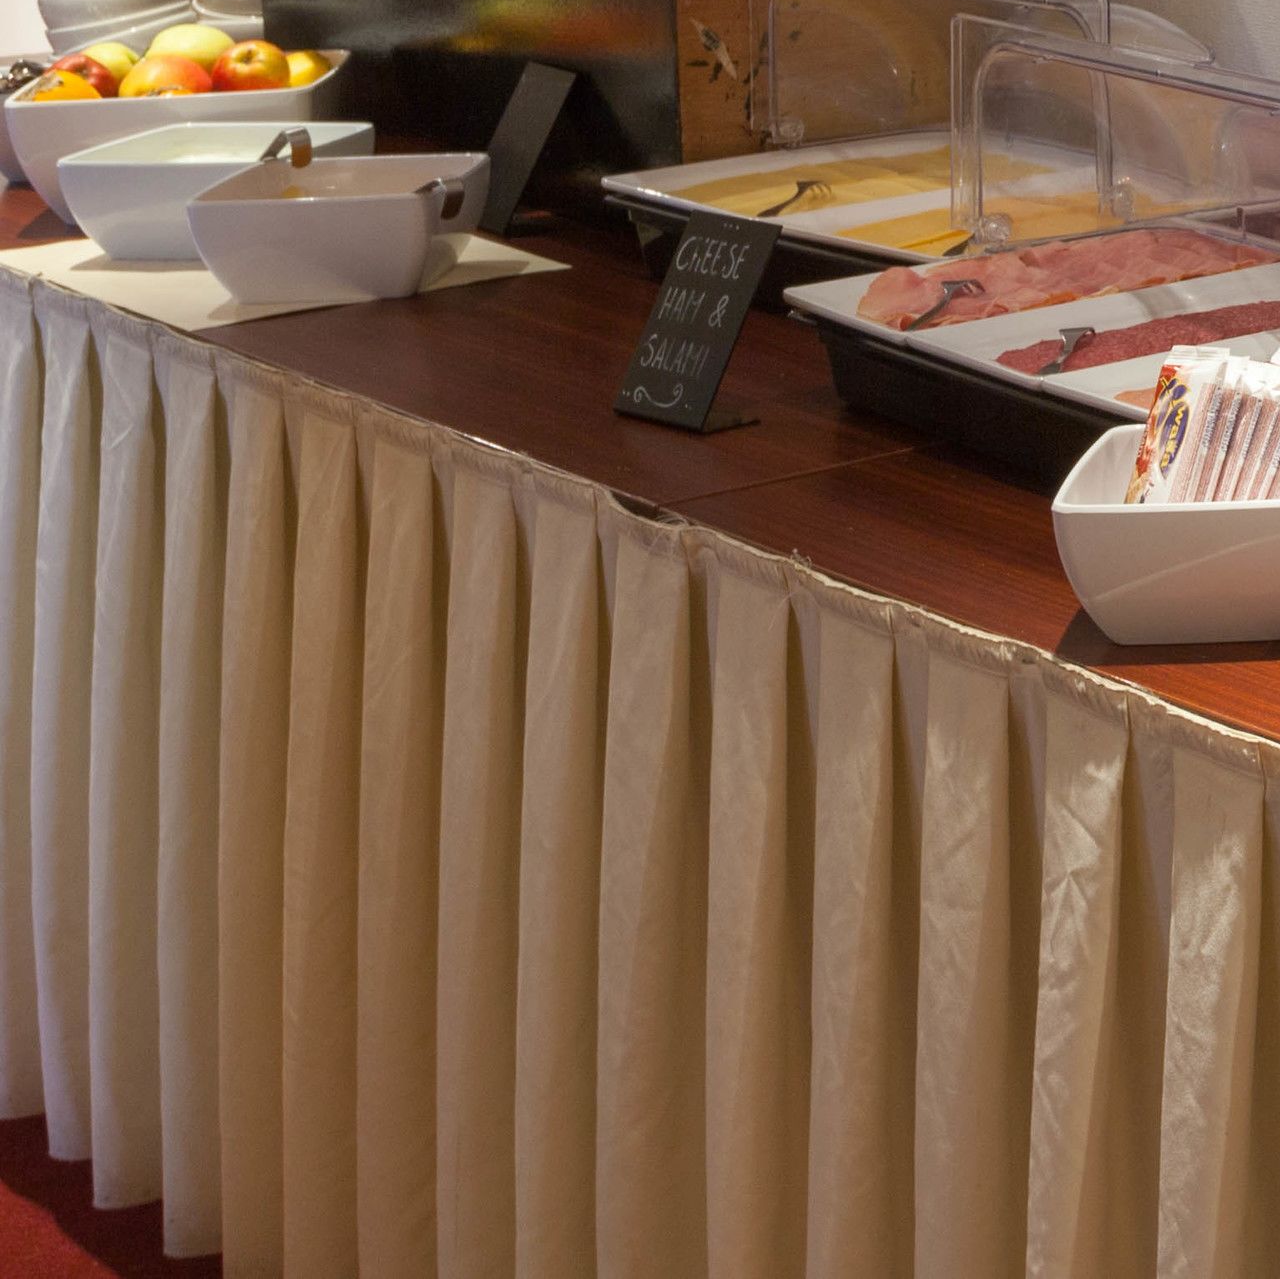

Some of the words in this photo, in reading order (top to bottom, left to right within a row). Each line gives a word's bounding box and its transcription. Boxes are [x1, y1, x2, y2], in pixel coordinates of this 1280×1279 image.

[676, 236, 750, 280] CHEESE
[658, 286, 705, 326] HAM
[708, 294, 730, 328] &
[641, 333, 710, 377] SALAMI
